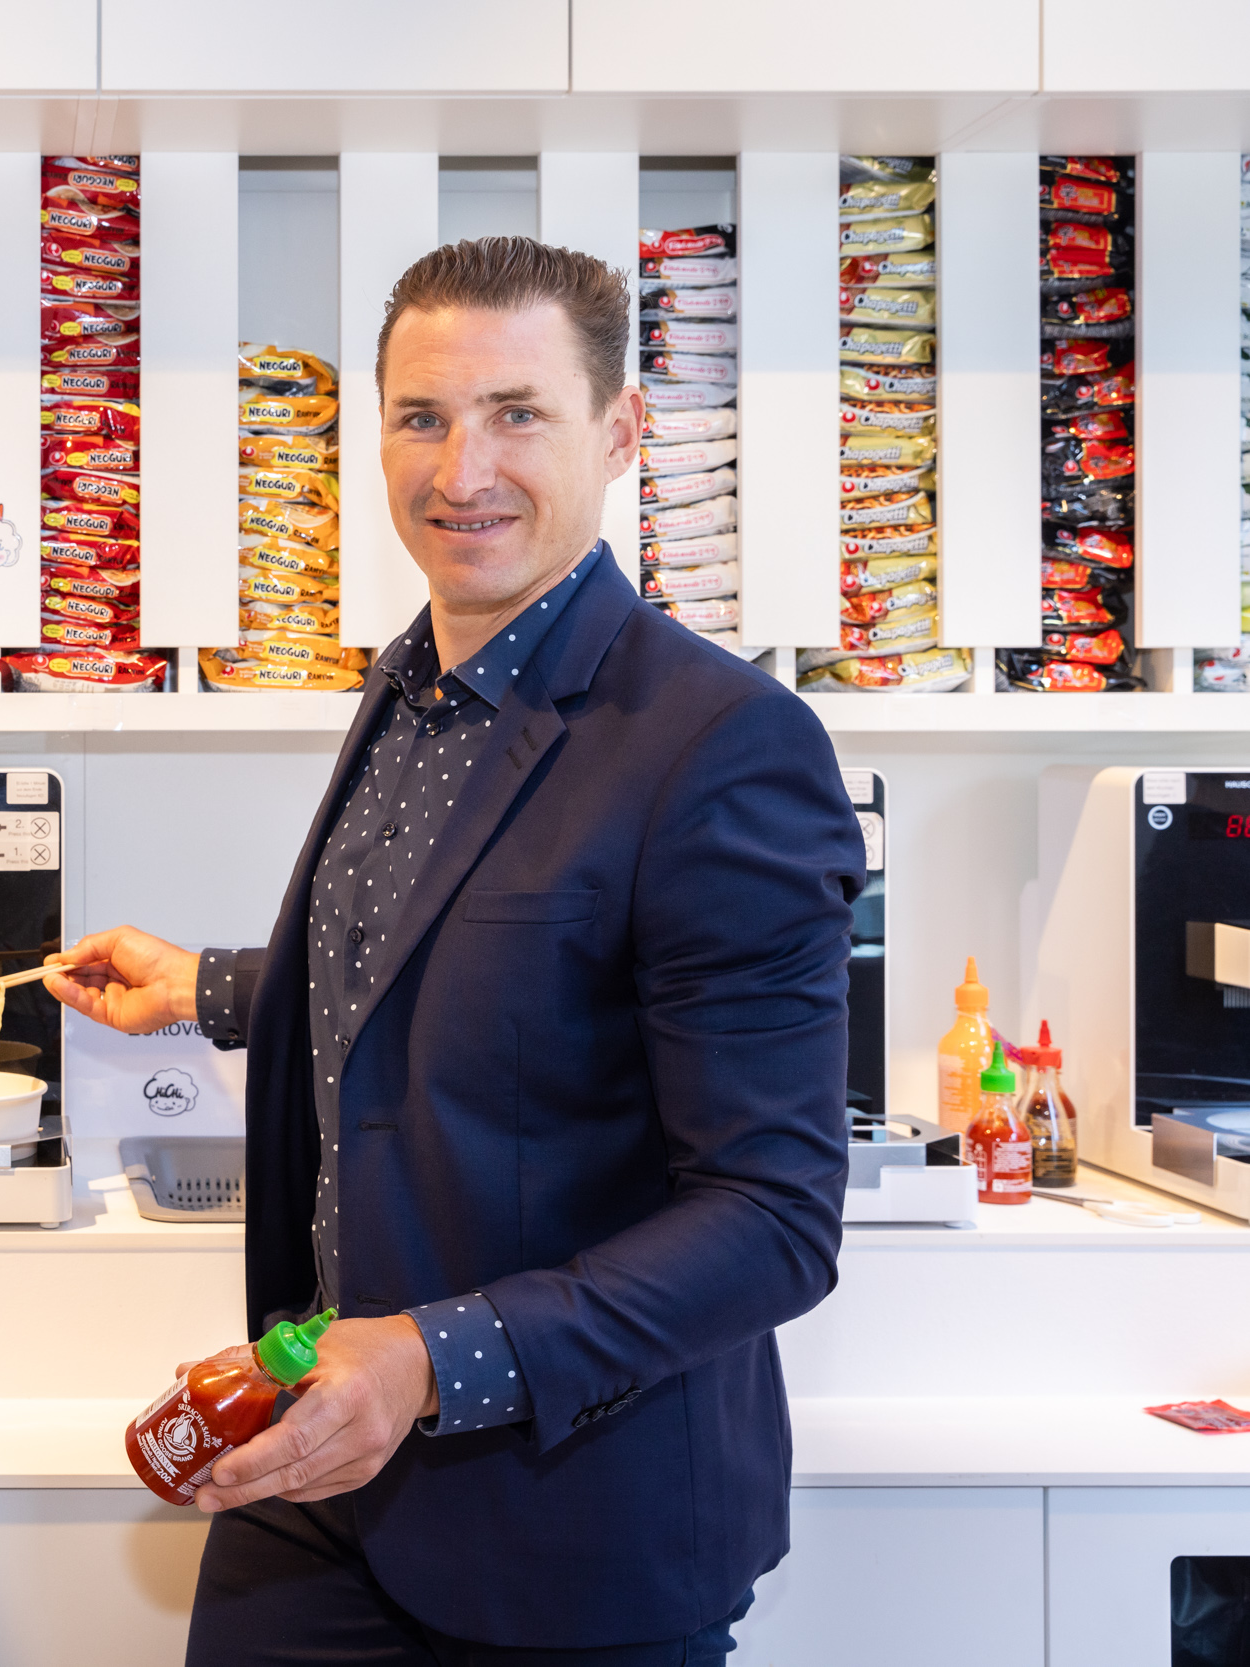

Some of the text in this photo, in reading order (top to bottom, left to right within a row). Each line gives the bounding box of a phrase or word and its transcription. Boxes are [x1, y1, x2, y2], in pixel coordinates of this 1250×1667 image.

[73, 174, 115, 188] NEOGURI
[50, 213, 92, 229] NEOGURI
[83, 253, 126, 268] NEOGURI
[75, 279, 117, 292] NEOGURI
[854, 294, 918, 315] Chapagetti
[82, 322, 122, 334] NEOGURI
[839, 337, 903, 355] Chapagetti
[69, 349, 112, 360] NEOGURI
[259, 361, 301, 371] NEOGURI
[62, 377, 105, 389] NEOGURI
[55, 413, 97, 426] NEOGURI
[248, 407, 291, 418] NEOGURI
[861, 414, 924, 429] Chapagetti
[89, 454, 132, 465] NEOGURI
[277, 451, 318, 464] NEOGURI
[77, 481, 119, 497] NEOGURI
[254, 477, 296, 492] NEOGURI
[844, 507, 908, 524] Chapagetti
[66, 516, 109, 530] NEOGURI
[249, 516, 289, 535] NEOGURI
[865, 536, 929, 554] Chapagetti
[51, 547, 94, 562] NEOGURI
[257, 551, 300, 571] NEOGURI
[72, 583, 115, 597] NEOGURI
[253, 581, 295, 596] NEOGURI
[67, 601, 109, 617] NEOGURI
[65, 628, 108, 641] NEOGURI
[869, 619, 930, 641] Chapagetti
[268, 645, 310, 659] NEOGURI
[72, 662, 114, 674] NEOGURI
[259, 669, 302, 680] NEOGURI
[15, 819, 25, 829] 2.
[14, 847, 23, 857] 1.
[178, 1403, 211, 1449] SRIRACHA SAUCE
[157, 1417, 194, 1463] FLYING GOOSE BRAND
[149, 1438, 173, 1471] ORIGINAL
[158, 1468, 172, 1482] 200
